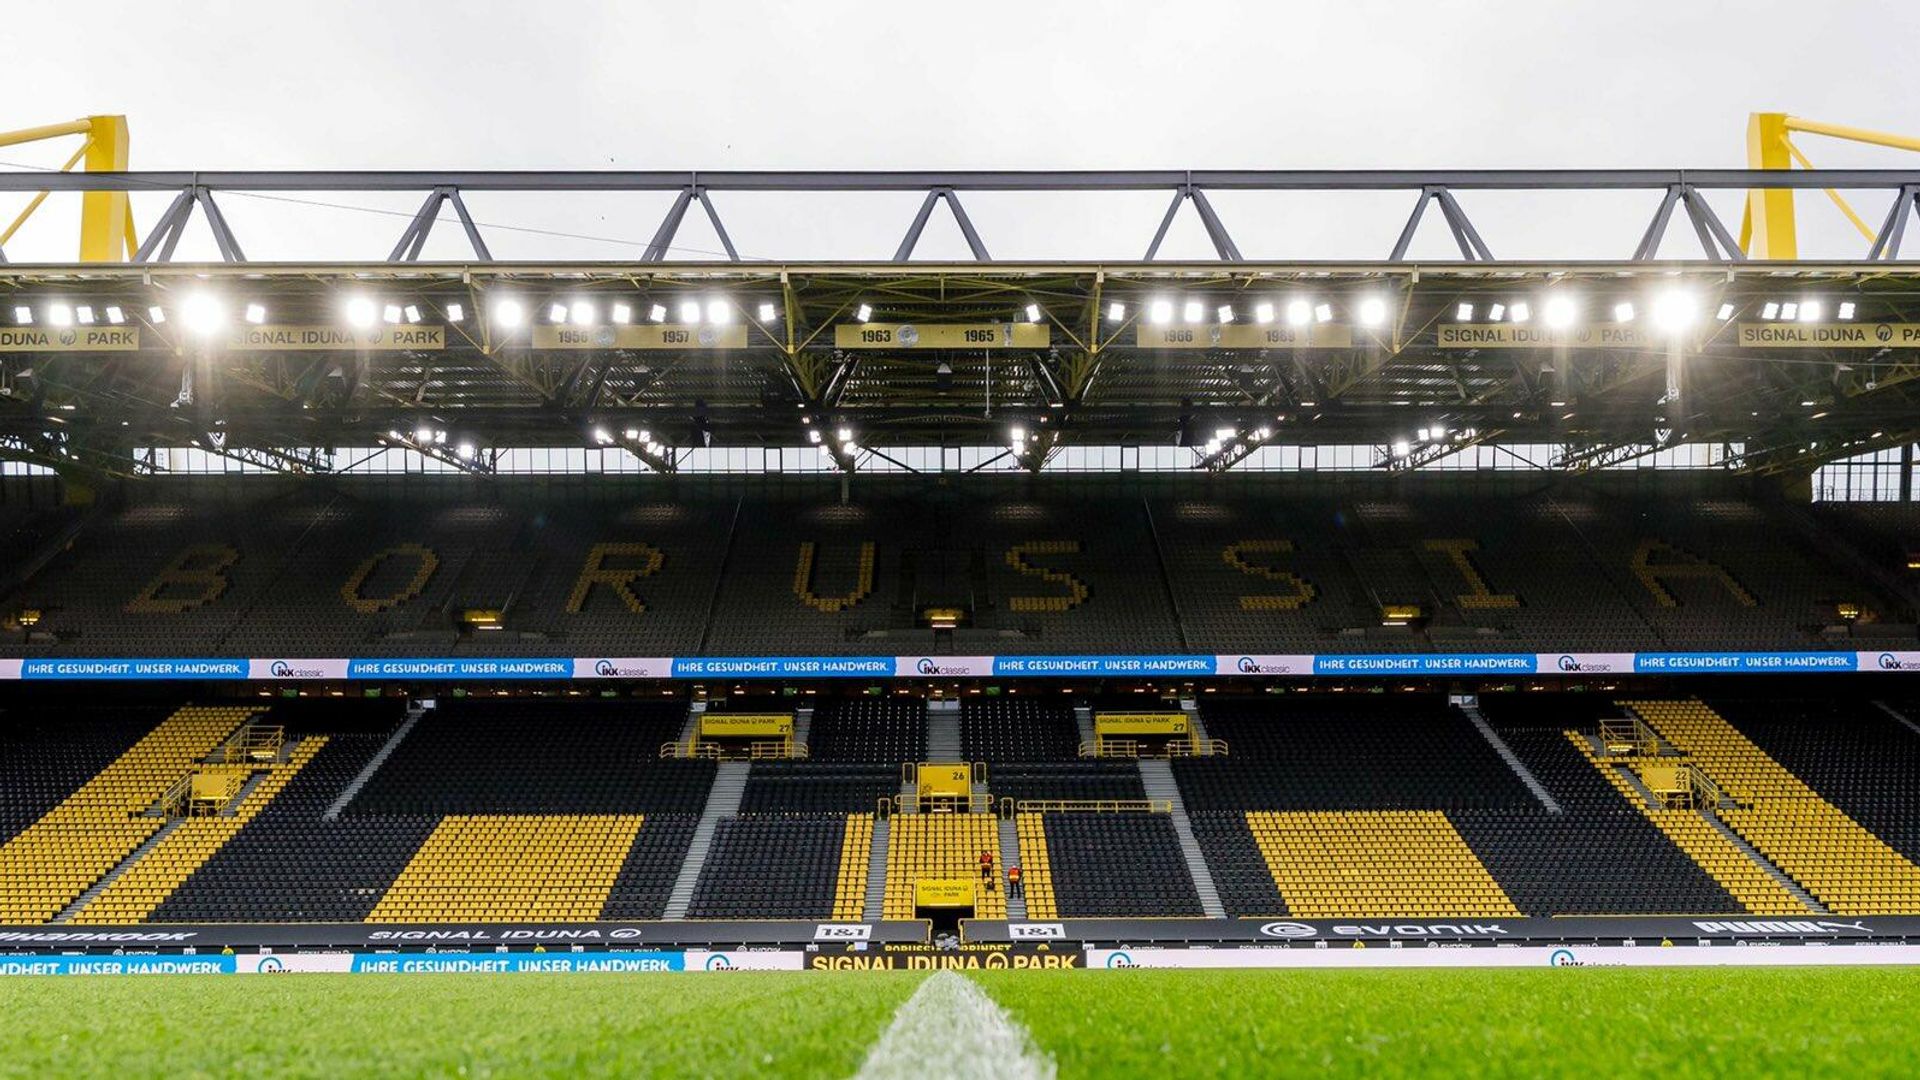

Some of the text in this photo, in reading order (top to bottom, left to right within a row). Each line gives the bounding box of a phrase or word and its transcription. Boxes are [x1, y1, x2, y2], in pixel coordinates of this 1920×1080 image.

[87, 332, 134, 344] PARK
[302, 332, 355, 343] IDUNA
[393, 331, 440, 343] PARK
[662, 330, 689, 342] 1957
[860, 330, 994, 342] 1963 1965
[1164, 330, 1193, 342] 1966
[1443, 329, 1506, 342] SIGNAL
[1744, 329, 1807, 341] SIGNAL
[1813, 329, 1865, 341] IDUNA
[678, 661, 887, 671] IHRE GESUNDHEIT. UNSER HANDWERK.
[999, 660, 1208, 670] IHRE GESUNDHEIT. UNSER HANDWERK.
[1320, 658, 1529, 668] IHRE GESUNDHEIT. UNSER HANDWERK.
[1640, 656, 1849, 666] IHRE GESUNDHEIT. UNSER HANDWERK.
[29, 663, 240, 674] IHRE GESUNDHEIT. UNSER HANDWERK.
[354, 663, 566, 673] IHRE GESUNDHEIT. UNSER HANDWERK.
[619, 667, 648, 677] classic
[940, 666, 970, 675] classic
[1261, 664, 1290, 674] classic
[1582, 663, 1611, 672] classic
[295, 669, 324, 677] classic
[779, 725, 790, 733] 27
[1173, 723, 1184, 731] 27
[952, 772, 964, 781] 26
[1675, 771, 1686, 780] 22
[1675, 781, 1686, 789] 21
[823, 928, 864, 936] 1&1
[1016, 927, 1058, 936] 1&1
[1692, 921, 1829, 933] PUMA
[368, 929, 602, 939] SIGNAL IDUNA
[360, 960, 398, 973] IHRE
[517, 959, 572, 972] UNSER
[813, 954, 1077, 970] SIGNAL IDUNA PARK
[69, 962, 123, 974] UNSER
